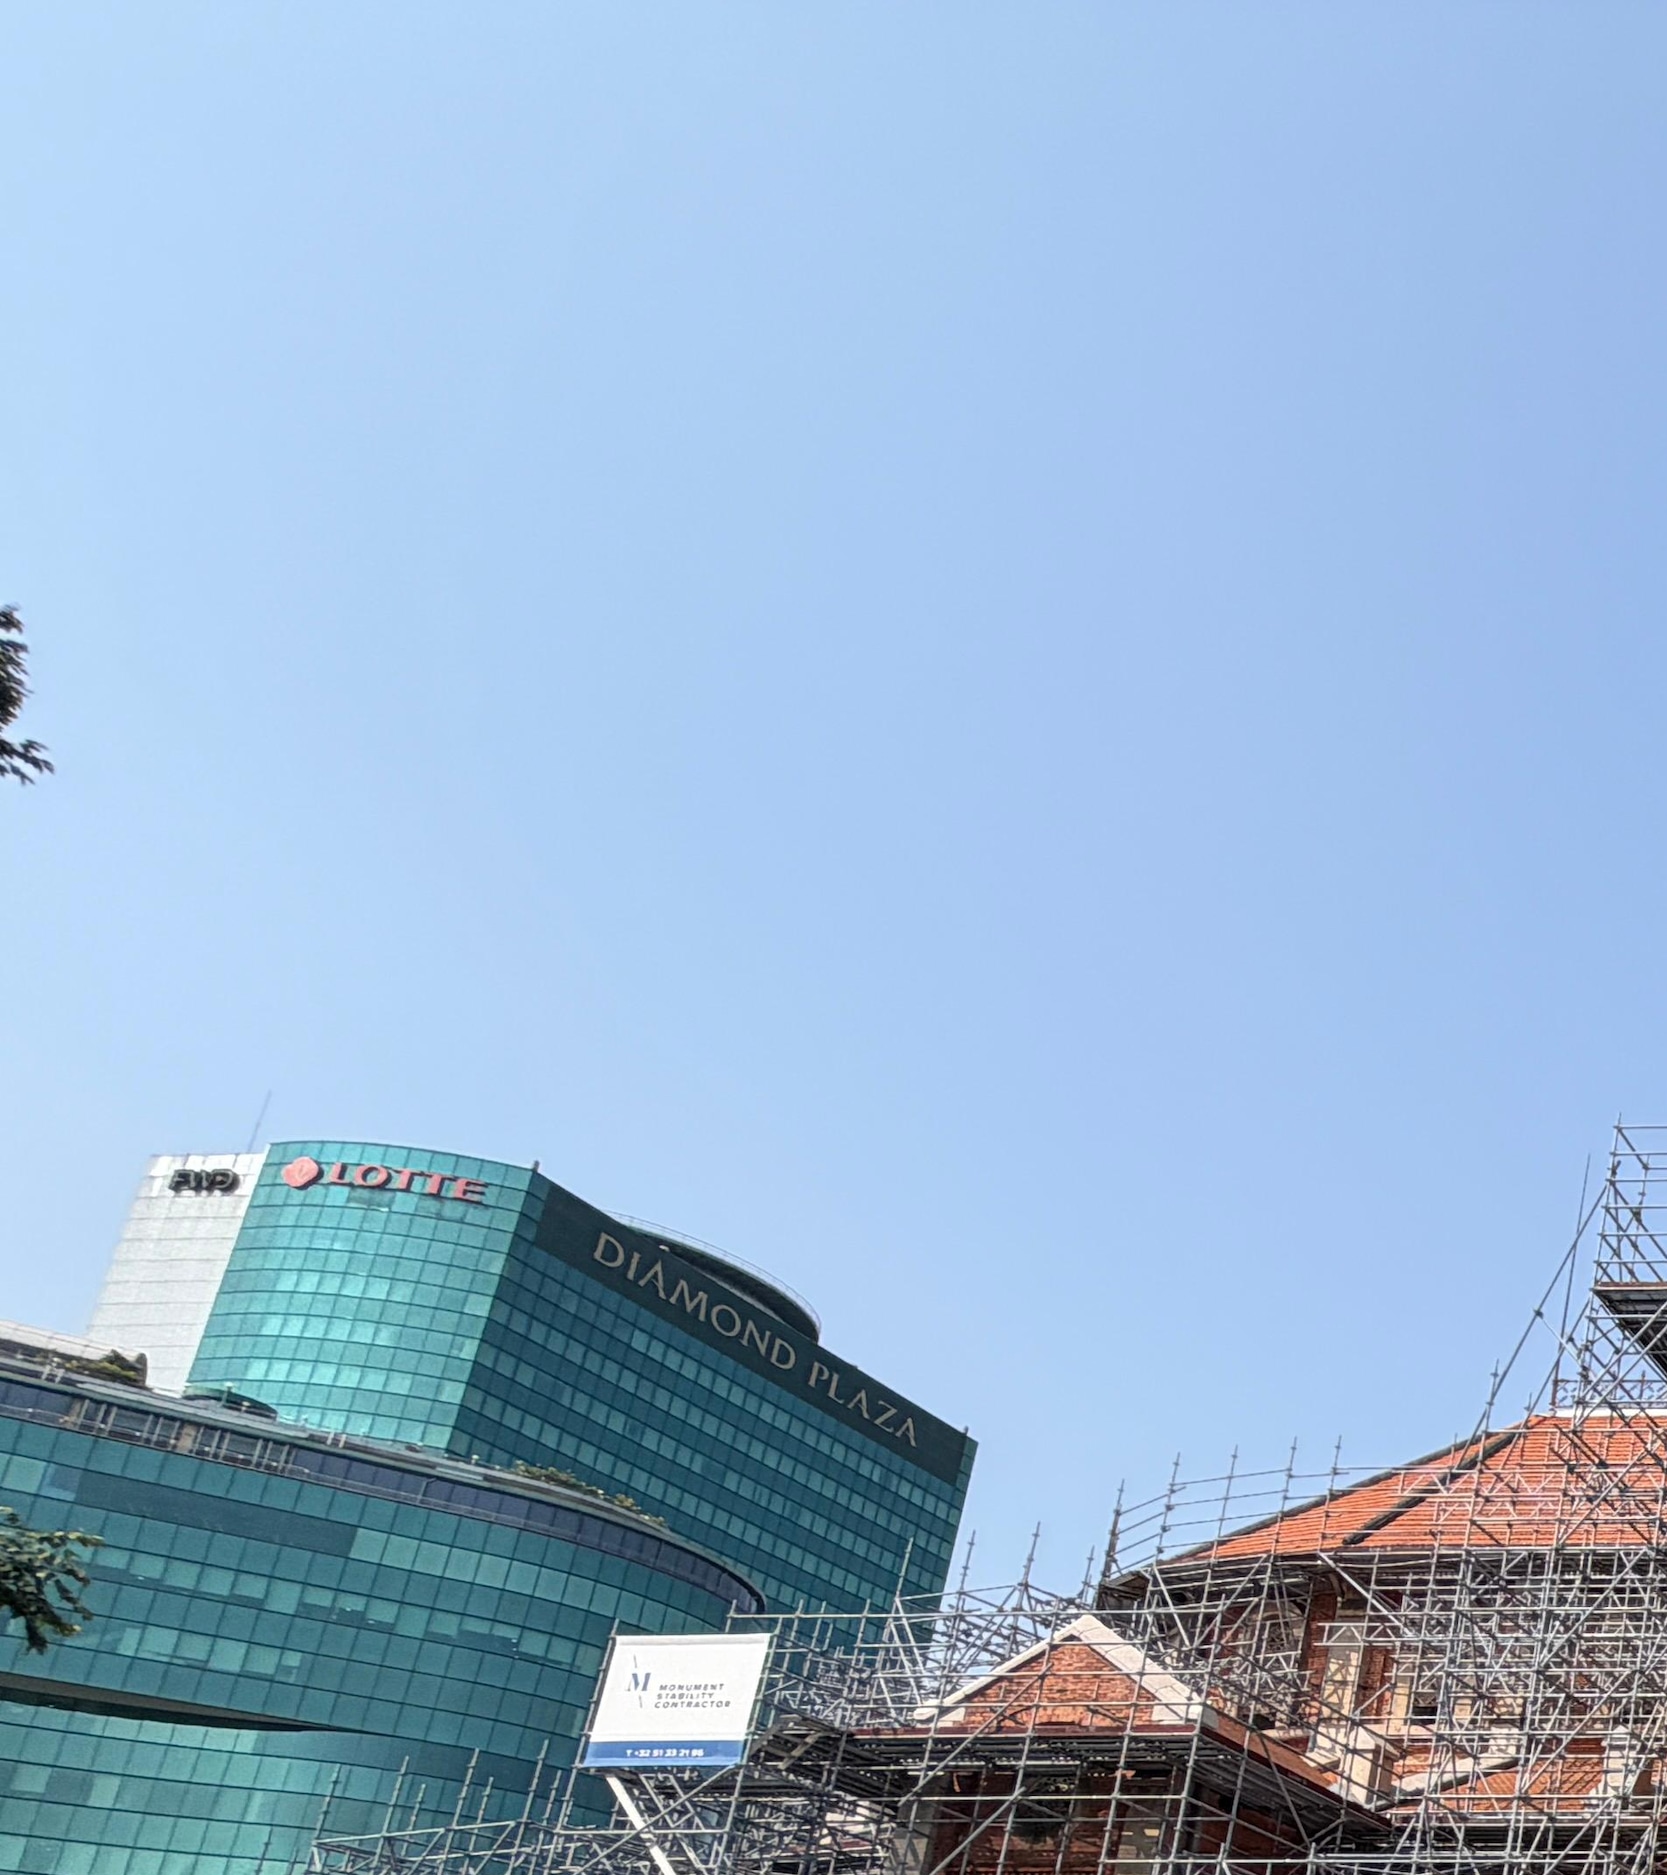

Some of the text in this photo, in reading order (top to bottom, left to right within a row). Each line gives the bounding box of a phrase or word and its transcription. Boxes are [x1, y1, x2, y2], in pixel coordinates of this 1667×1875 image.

[328, 1161, 487, 1203] LOTTE
[593, 1232, 917, 1448] DIAMOND PLAZA
[659, 1683, 724, 1692] MONUMENT
[657, 1692, 714, 1700] STABILITY
[654, 1700, 731, 1709] CONTRACTOR
